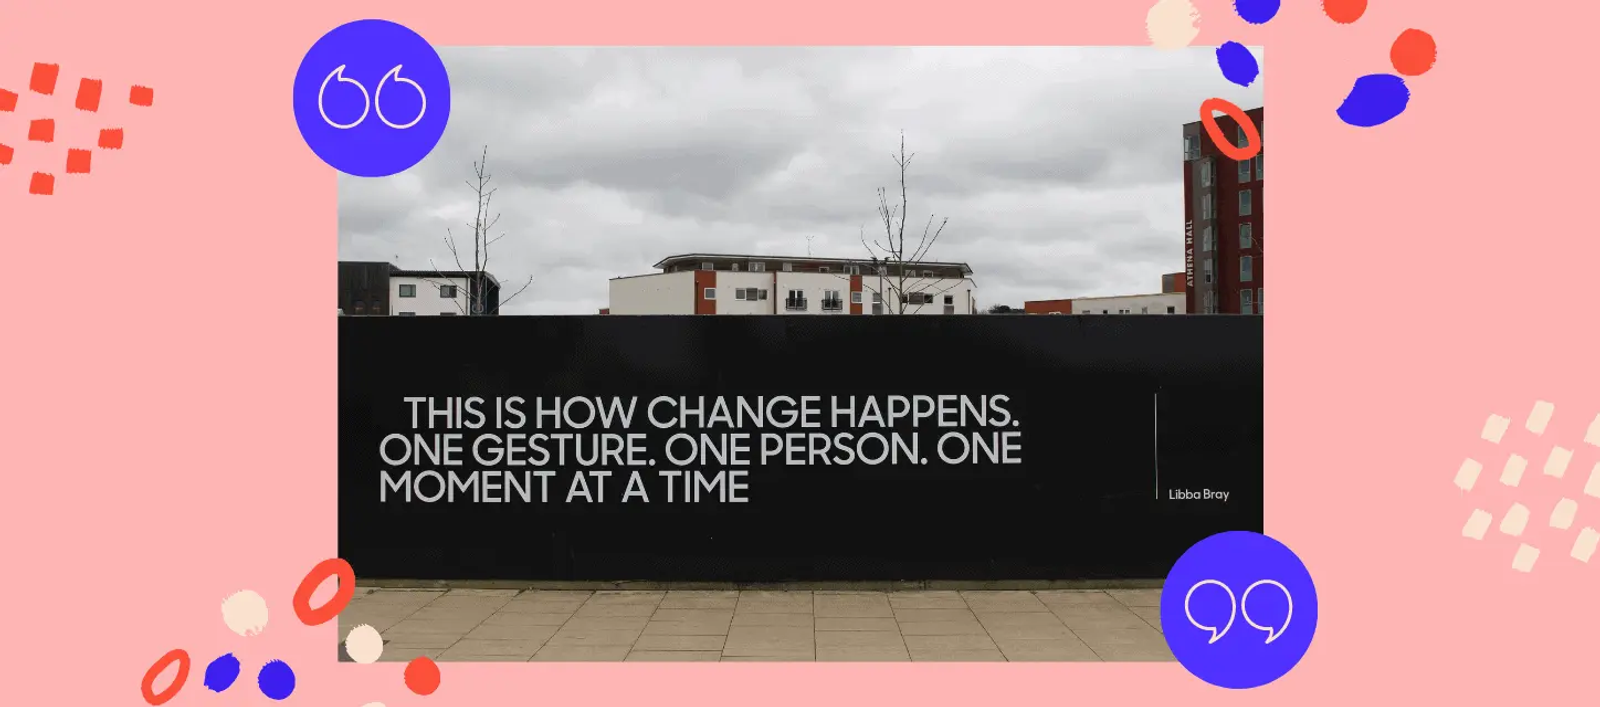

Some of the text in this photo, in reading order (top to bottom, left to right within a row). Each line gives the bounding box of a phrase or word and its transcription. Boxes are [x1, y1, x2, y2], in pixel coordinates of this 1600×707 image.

[403, 394, 1020, 429] THIS IS HOW CHANGE HAPPENS.
[379, 431, 1022, 467] ONE GESTURE. ONE PERSON. ONE
[380, 470, 749, 503] MOMENT AT A TIME
[1168, 488, 1230, 502] Libba Bray
